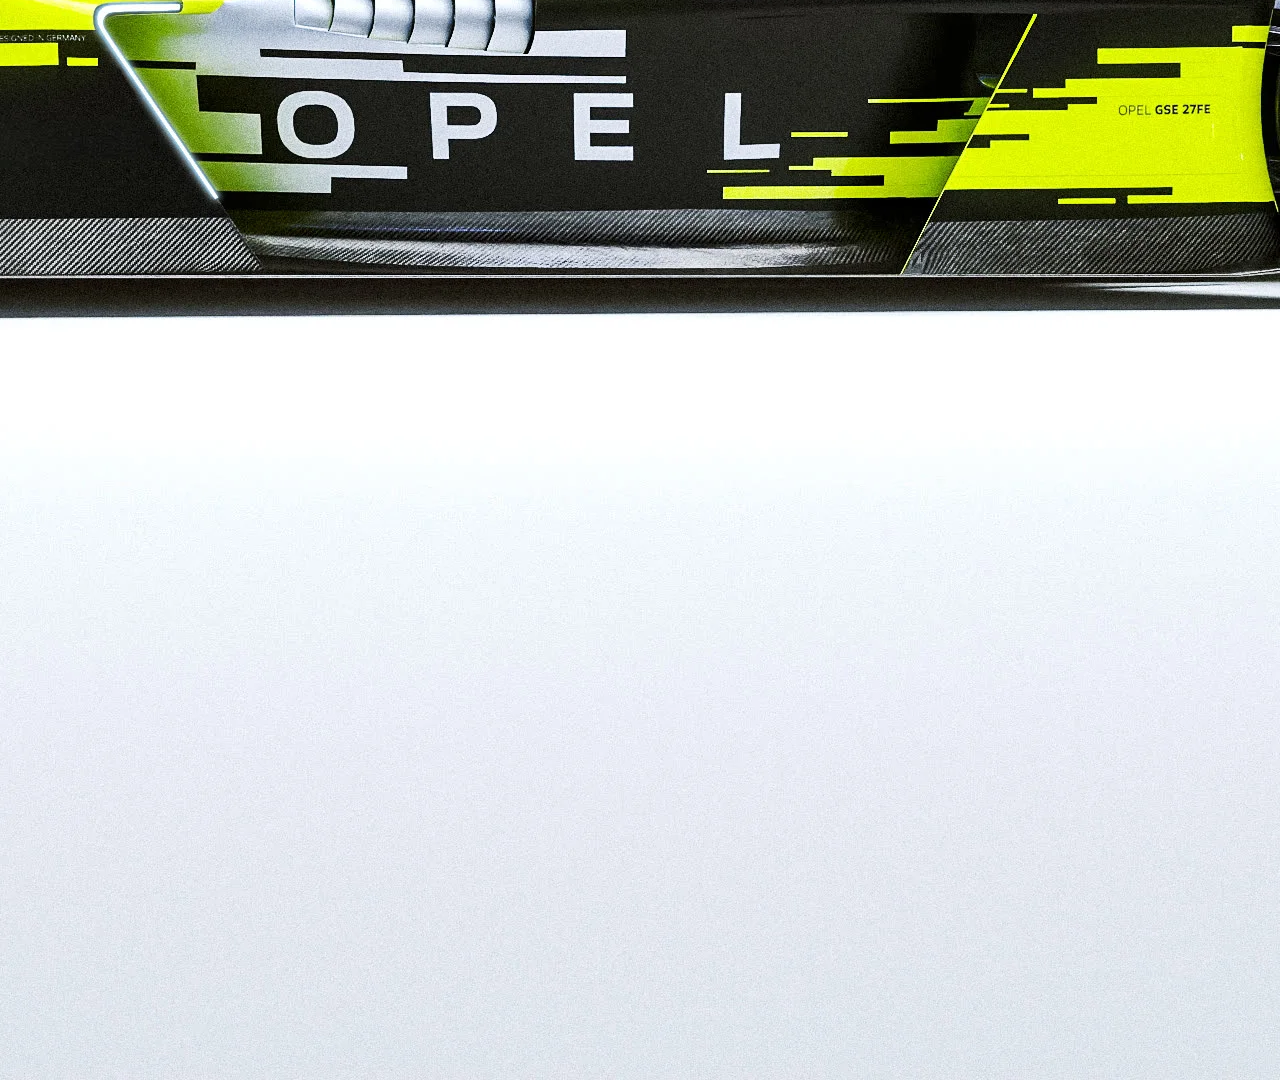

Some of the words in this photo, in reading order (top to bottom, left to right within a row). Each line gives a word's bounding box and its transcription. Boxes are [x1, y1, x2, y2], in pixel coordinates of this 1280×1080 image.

[46, 34, 87, 42] GERMANY
[1118, 104, 1151, 116] OPEL
[1155, 104, 1179, 115] GSE
[1182, 104, 1211, 115] 27FE
[276, 90, 781, 161] OPEL
